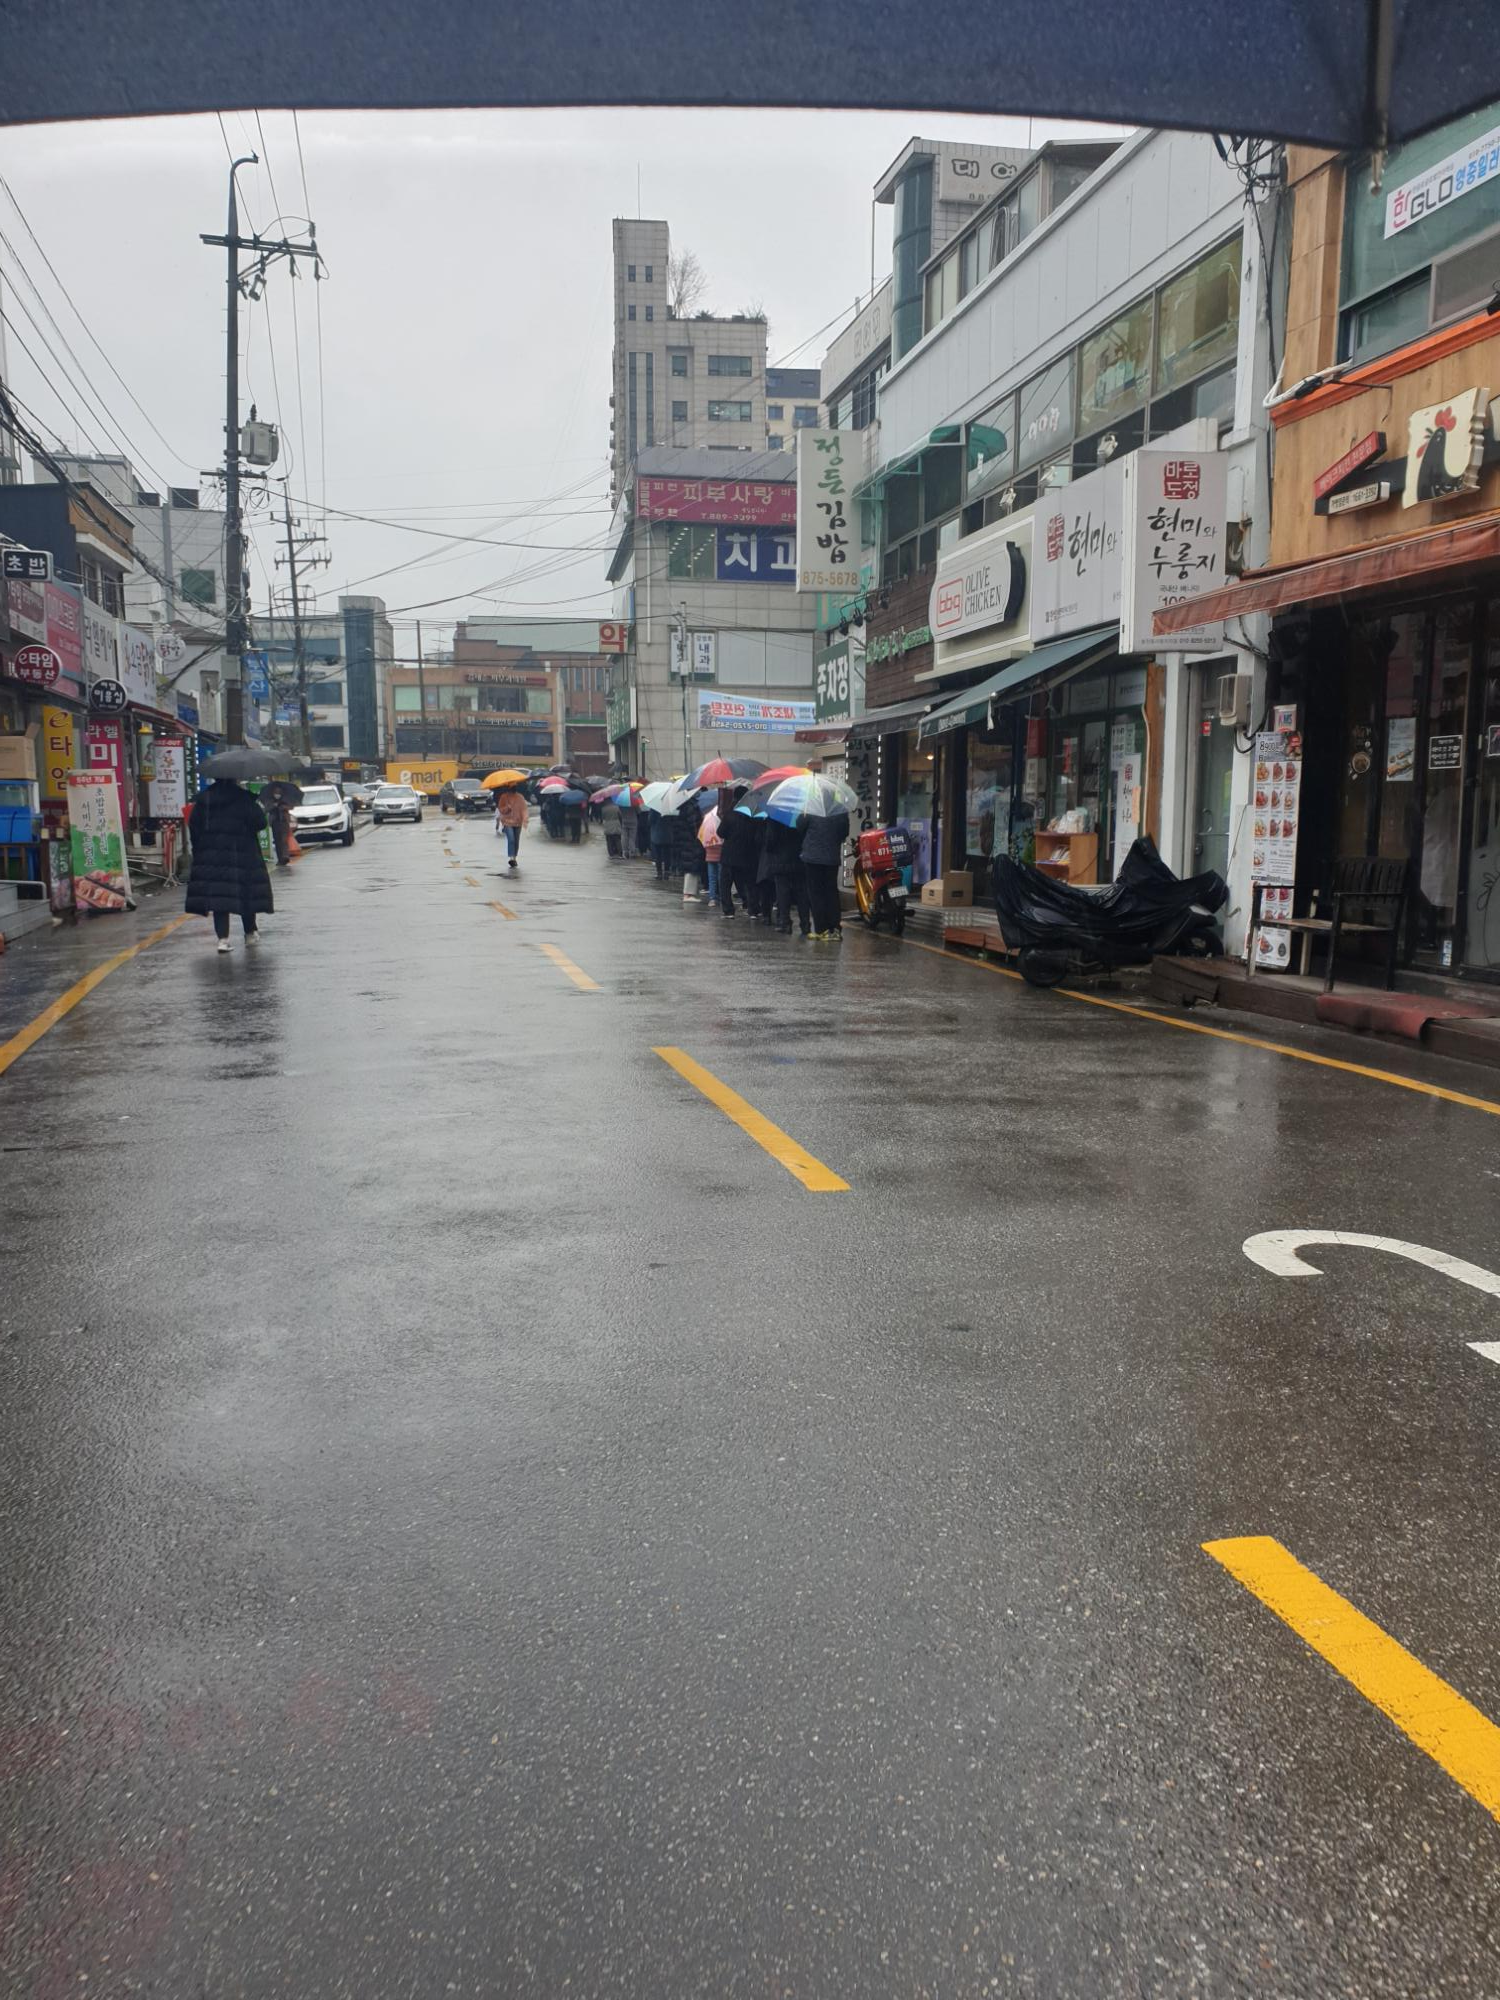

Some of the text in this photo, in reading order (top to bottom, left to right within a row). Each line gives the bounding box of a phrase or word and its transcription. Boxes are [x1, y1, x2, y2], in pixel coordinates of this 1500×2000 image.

[684, 483, 774, 505] 피부사랑
[7, 555, 45, 576] 초밥
[1148, 543, 1216, 580] 누룽지
[803, 571, 858, 585] 875-5678
[965, 567, 990, 594] OLIVE
[940, 592, 960, 615] bbq
[965, 585, 1002, 616] CHICKEN
[600, 623, 626, 653] 약
[698, 643, 710, 664] 내과
[818, 656, 848, 706] 주차장
[401, 769, 444, 783] emart
